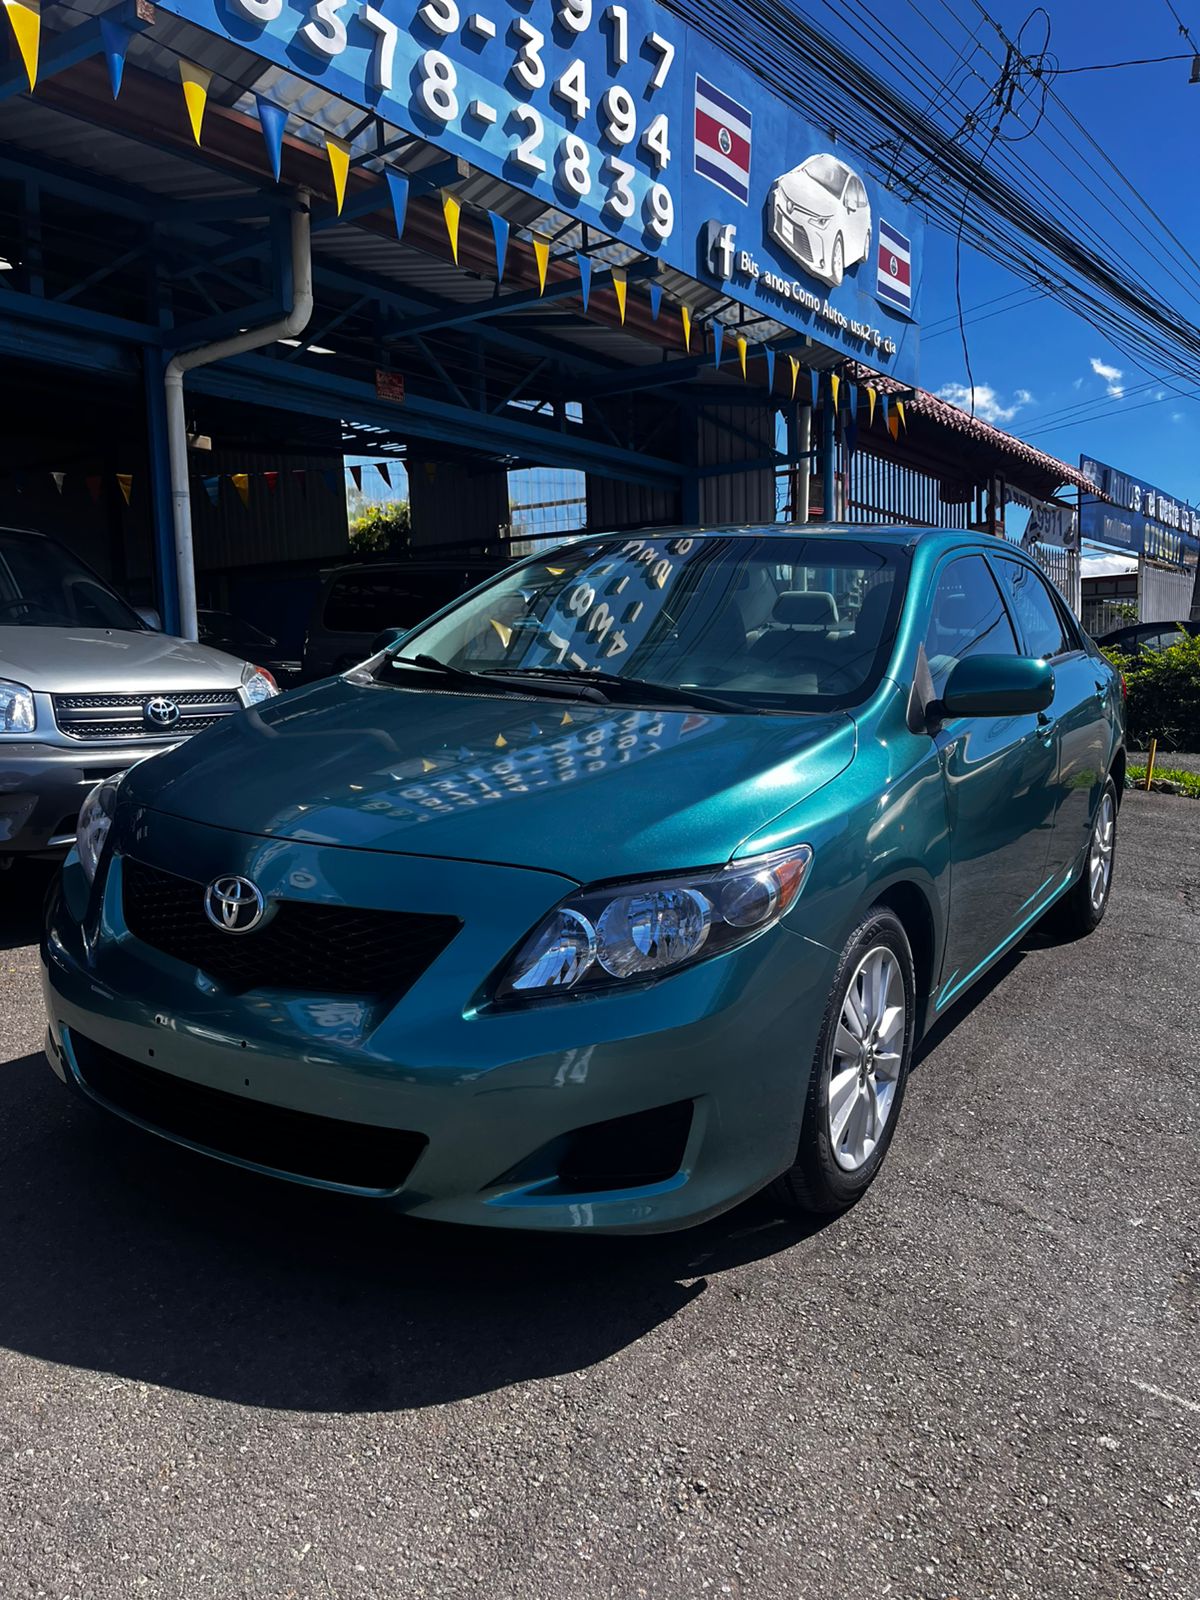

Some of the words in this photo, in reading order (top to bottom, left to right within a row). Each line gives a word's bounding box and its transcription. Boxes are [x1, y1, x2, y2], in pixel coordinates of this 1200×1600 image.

[240, 0, 674, 239] 378-2839
[791, 281, 820, 311] Como
[822, 299, 848, 328] Autos
